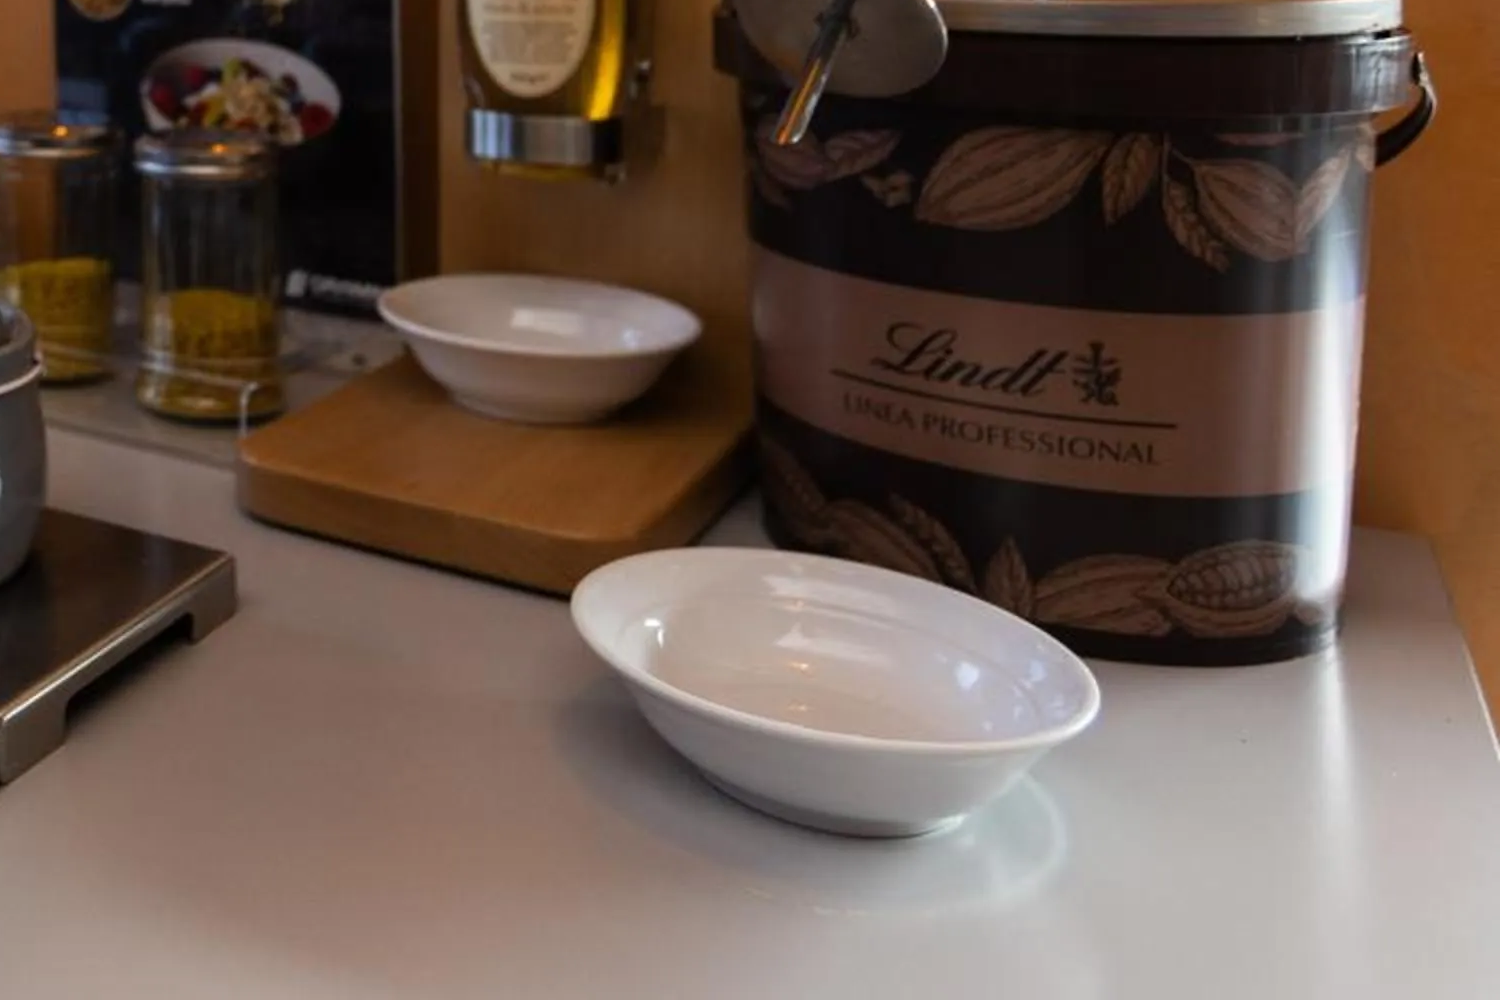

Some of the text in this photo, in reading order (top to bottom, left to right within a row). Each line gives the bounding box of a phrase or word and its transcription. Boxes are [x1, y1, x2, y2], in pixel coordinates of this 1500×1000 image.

[870, 321, 1070, 398] Lindt
[843, 392, 1160, 465] LINEA PROFESSIONAL
